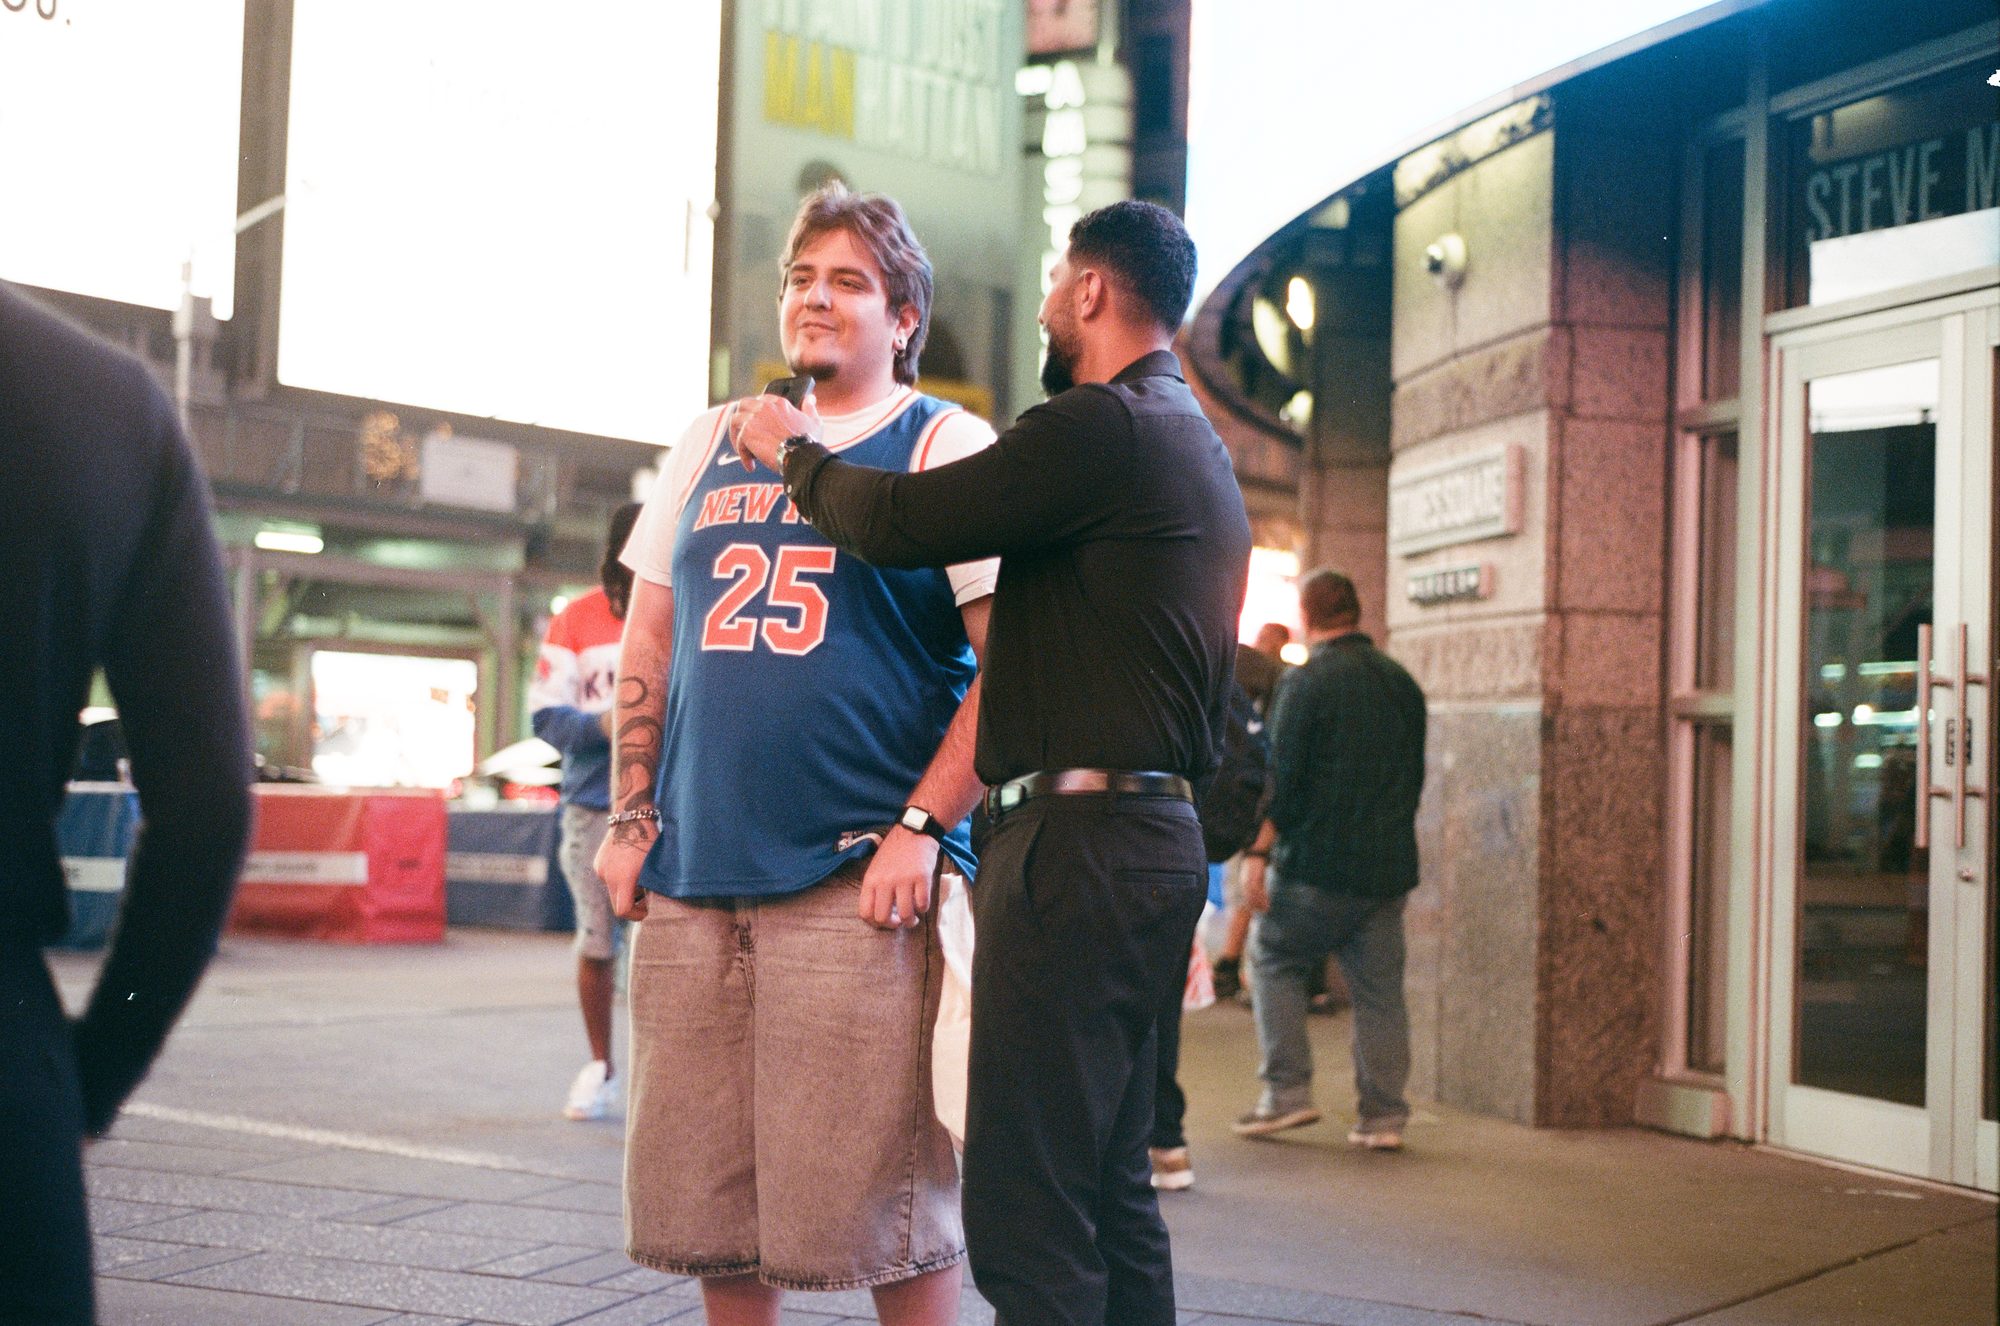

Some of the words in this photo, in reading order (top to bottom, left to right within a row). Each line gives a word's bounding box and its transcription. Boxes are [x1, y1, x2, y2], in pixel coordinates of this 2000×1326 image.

[1806, 140, 1944, 241] STEVE
[693, 484, 785, 531] NEW
[702, 543, 836, 655] 25
